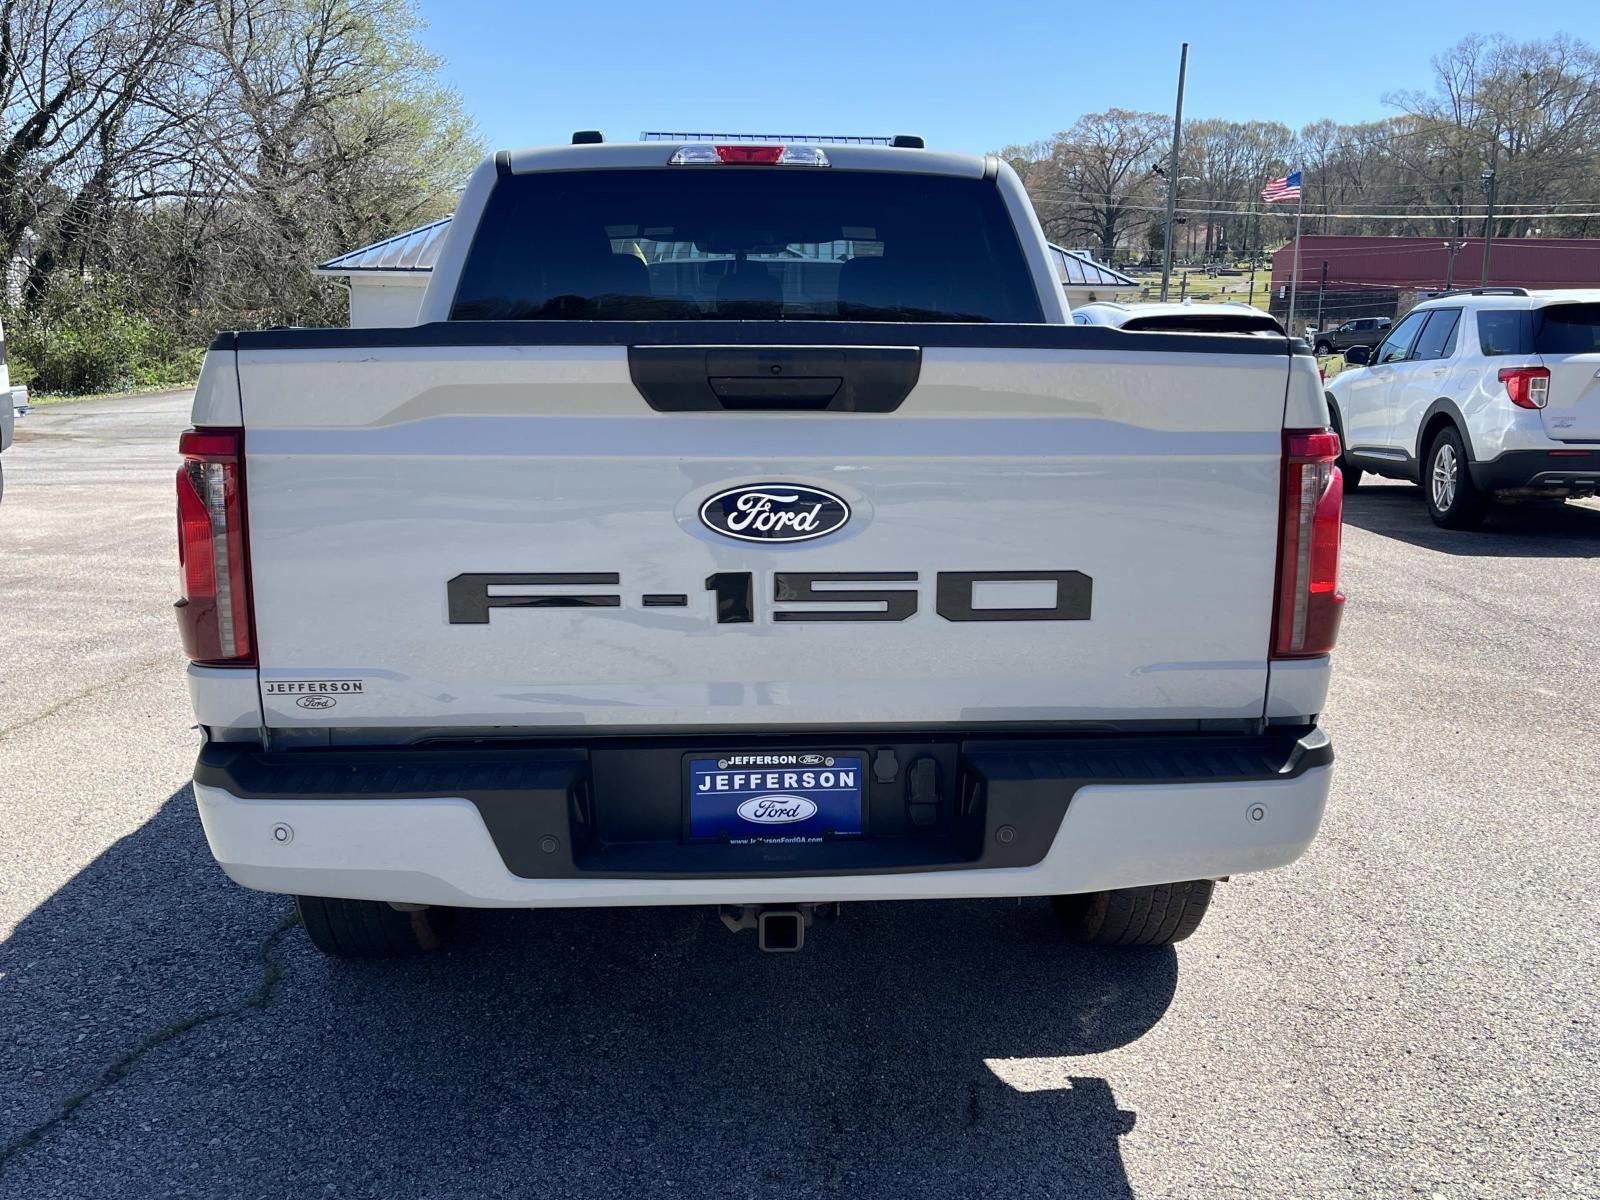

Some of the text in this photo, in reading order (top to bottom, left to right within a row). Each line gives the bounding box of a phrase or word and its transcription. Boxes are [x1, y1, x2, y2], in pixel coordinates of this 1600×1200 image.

[727, 493, 823, 531] Ford
[446, 569, 1093, 624] F-150
[267, 682, 363, 693] JEFFERSON
[303, 697, 329, 707] Ford
[728, 755, 797, 765] JEFFERSON
[698, 771, 855, 791] JEFFERSON
[753, 799, 800, 819] Ford
